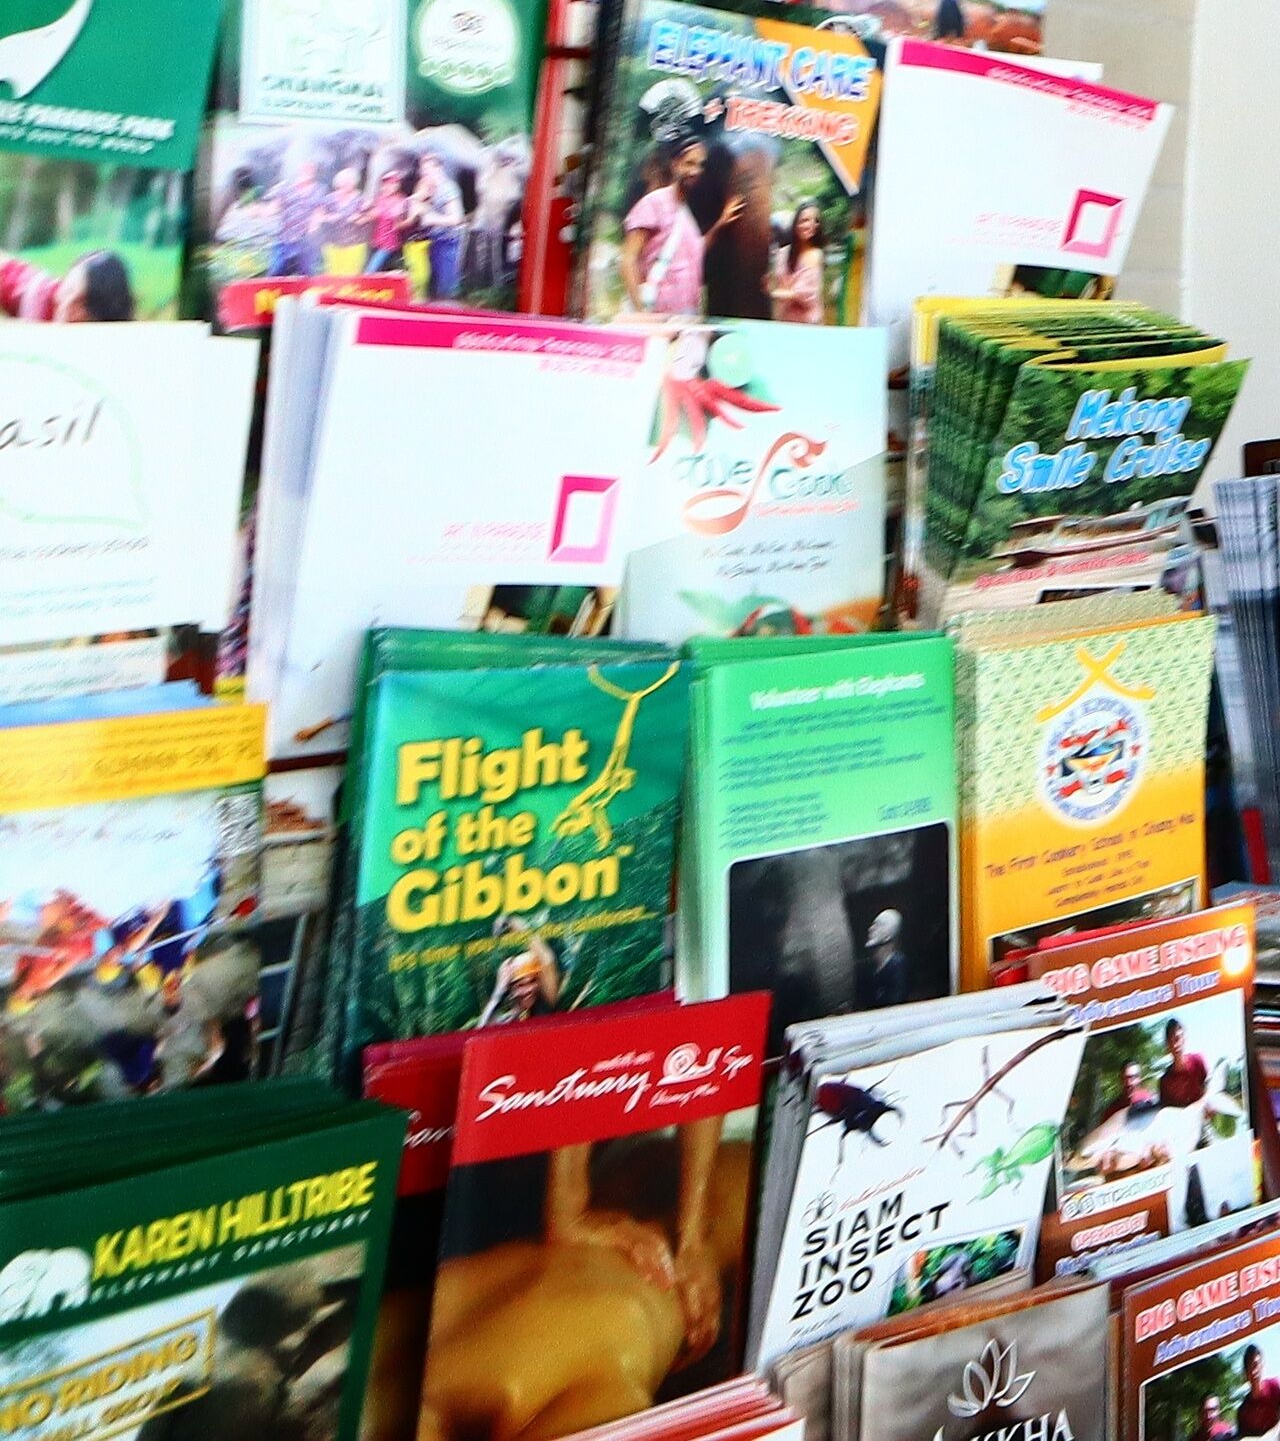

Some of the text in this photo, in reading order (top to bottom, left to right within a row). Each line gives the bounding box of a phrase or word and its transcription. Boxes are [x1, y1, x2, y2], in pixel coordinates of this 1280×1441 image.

[648, 18, 877, 102] ELEPHANT CARE
[1065, 385, 1193, 443] Mekong
[996, 434, 1212, 495] Smile Cruise
[395, 726, 590, 807] Flight
[391, 805, 538, 865] of the
[386, 851, 621, 935] Gibbon
[1091, 945, 1161, 990] GAME
[1159, 922, 1250, 972] FISHING
[1173, 971, 1222, 1000] Tour
[475, 1067, 651, 1123] Sanctuary
[92, 1161, 379, 1282] KAREN HILLTRIBE
[799, 1200, 952, 1291] INSECT
[800, 1190, 906, 1258] SIAM
[789, 1265, 874, 1323] ZOO
[1136, 1298, 1178, 1344] BIG
[1176, 1271, 1240, 1322] GAME
[1153, 1309, 1254, 1367] Adventure
